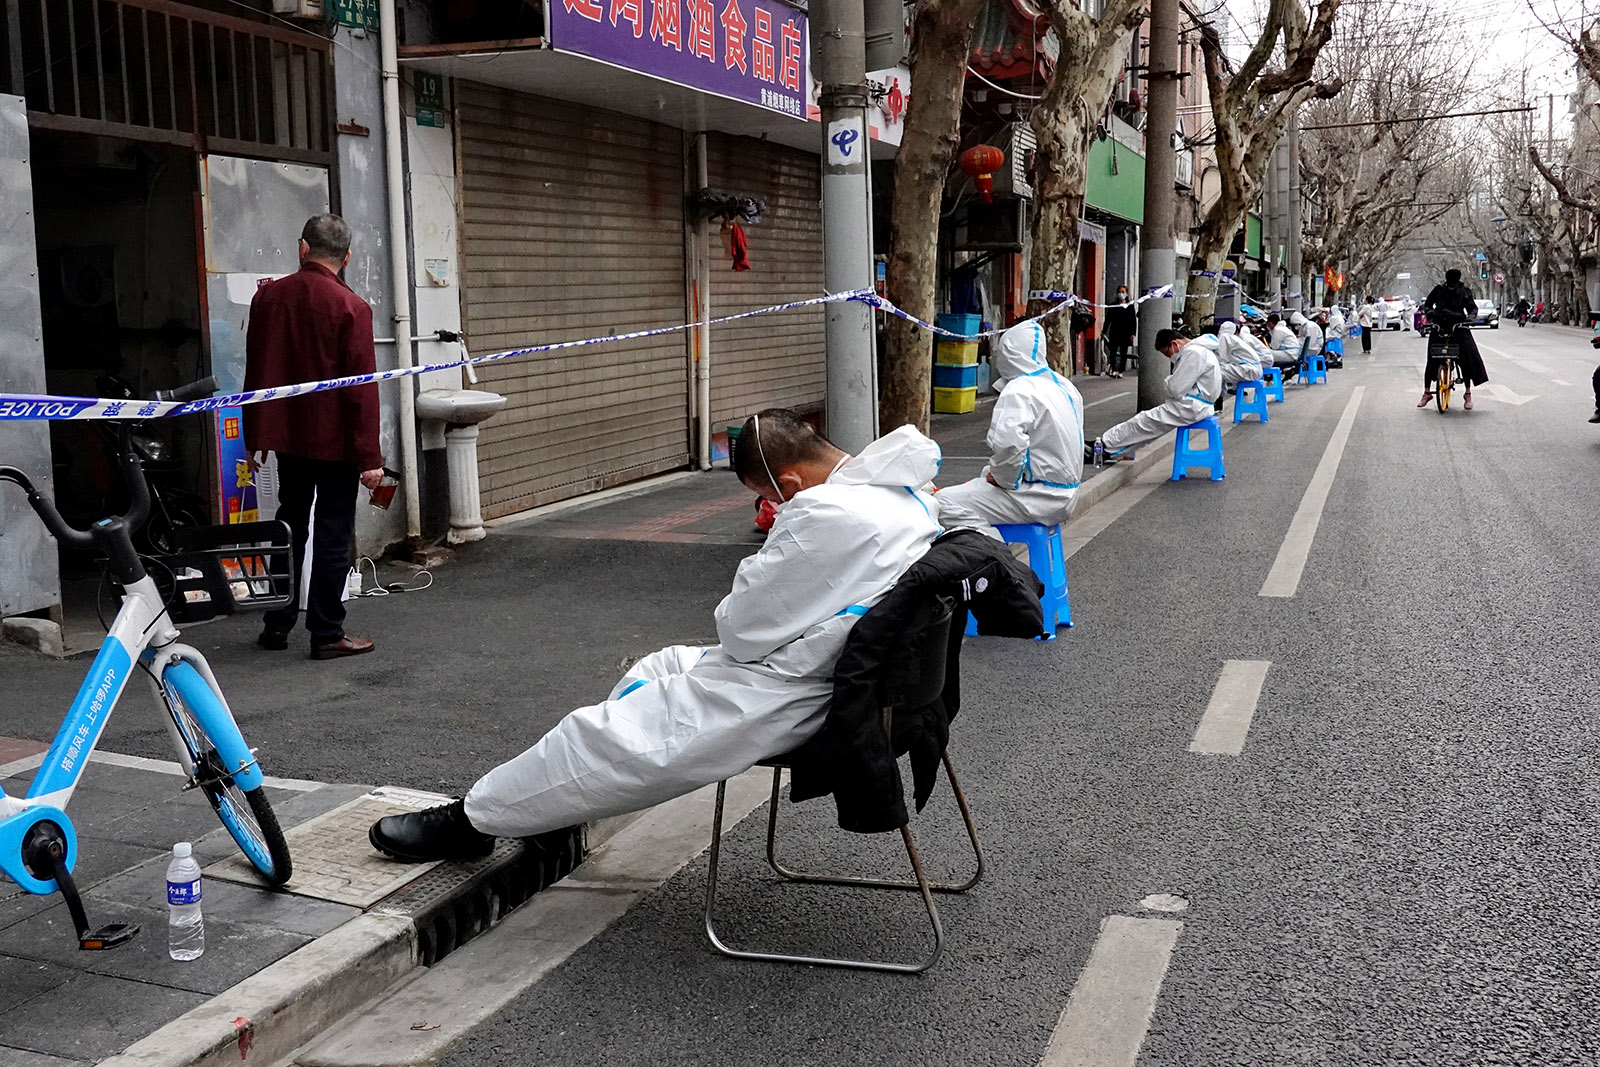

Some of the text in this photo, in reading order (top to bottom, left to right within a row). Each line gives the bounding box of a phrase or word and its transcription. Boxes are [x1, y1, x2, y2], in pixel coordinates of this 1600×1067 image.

[562, 0, 801, 92] 烟酒食品店
[422, 77, 436, 96] 19
[0, 401, 78, 417] POLICE
[61, 723, 90, 773] 搭顺风车
